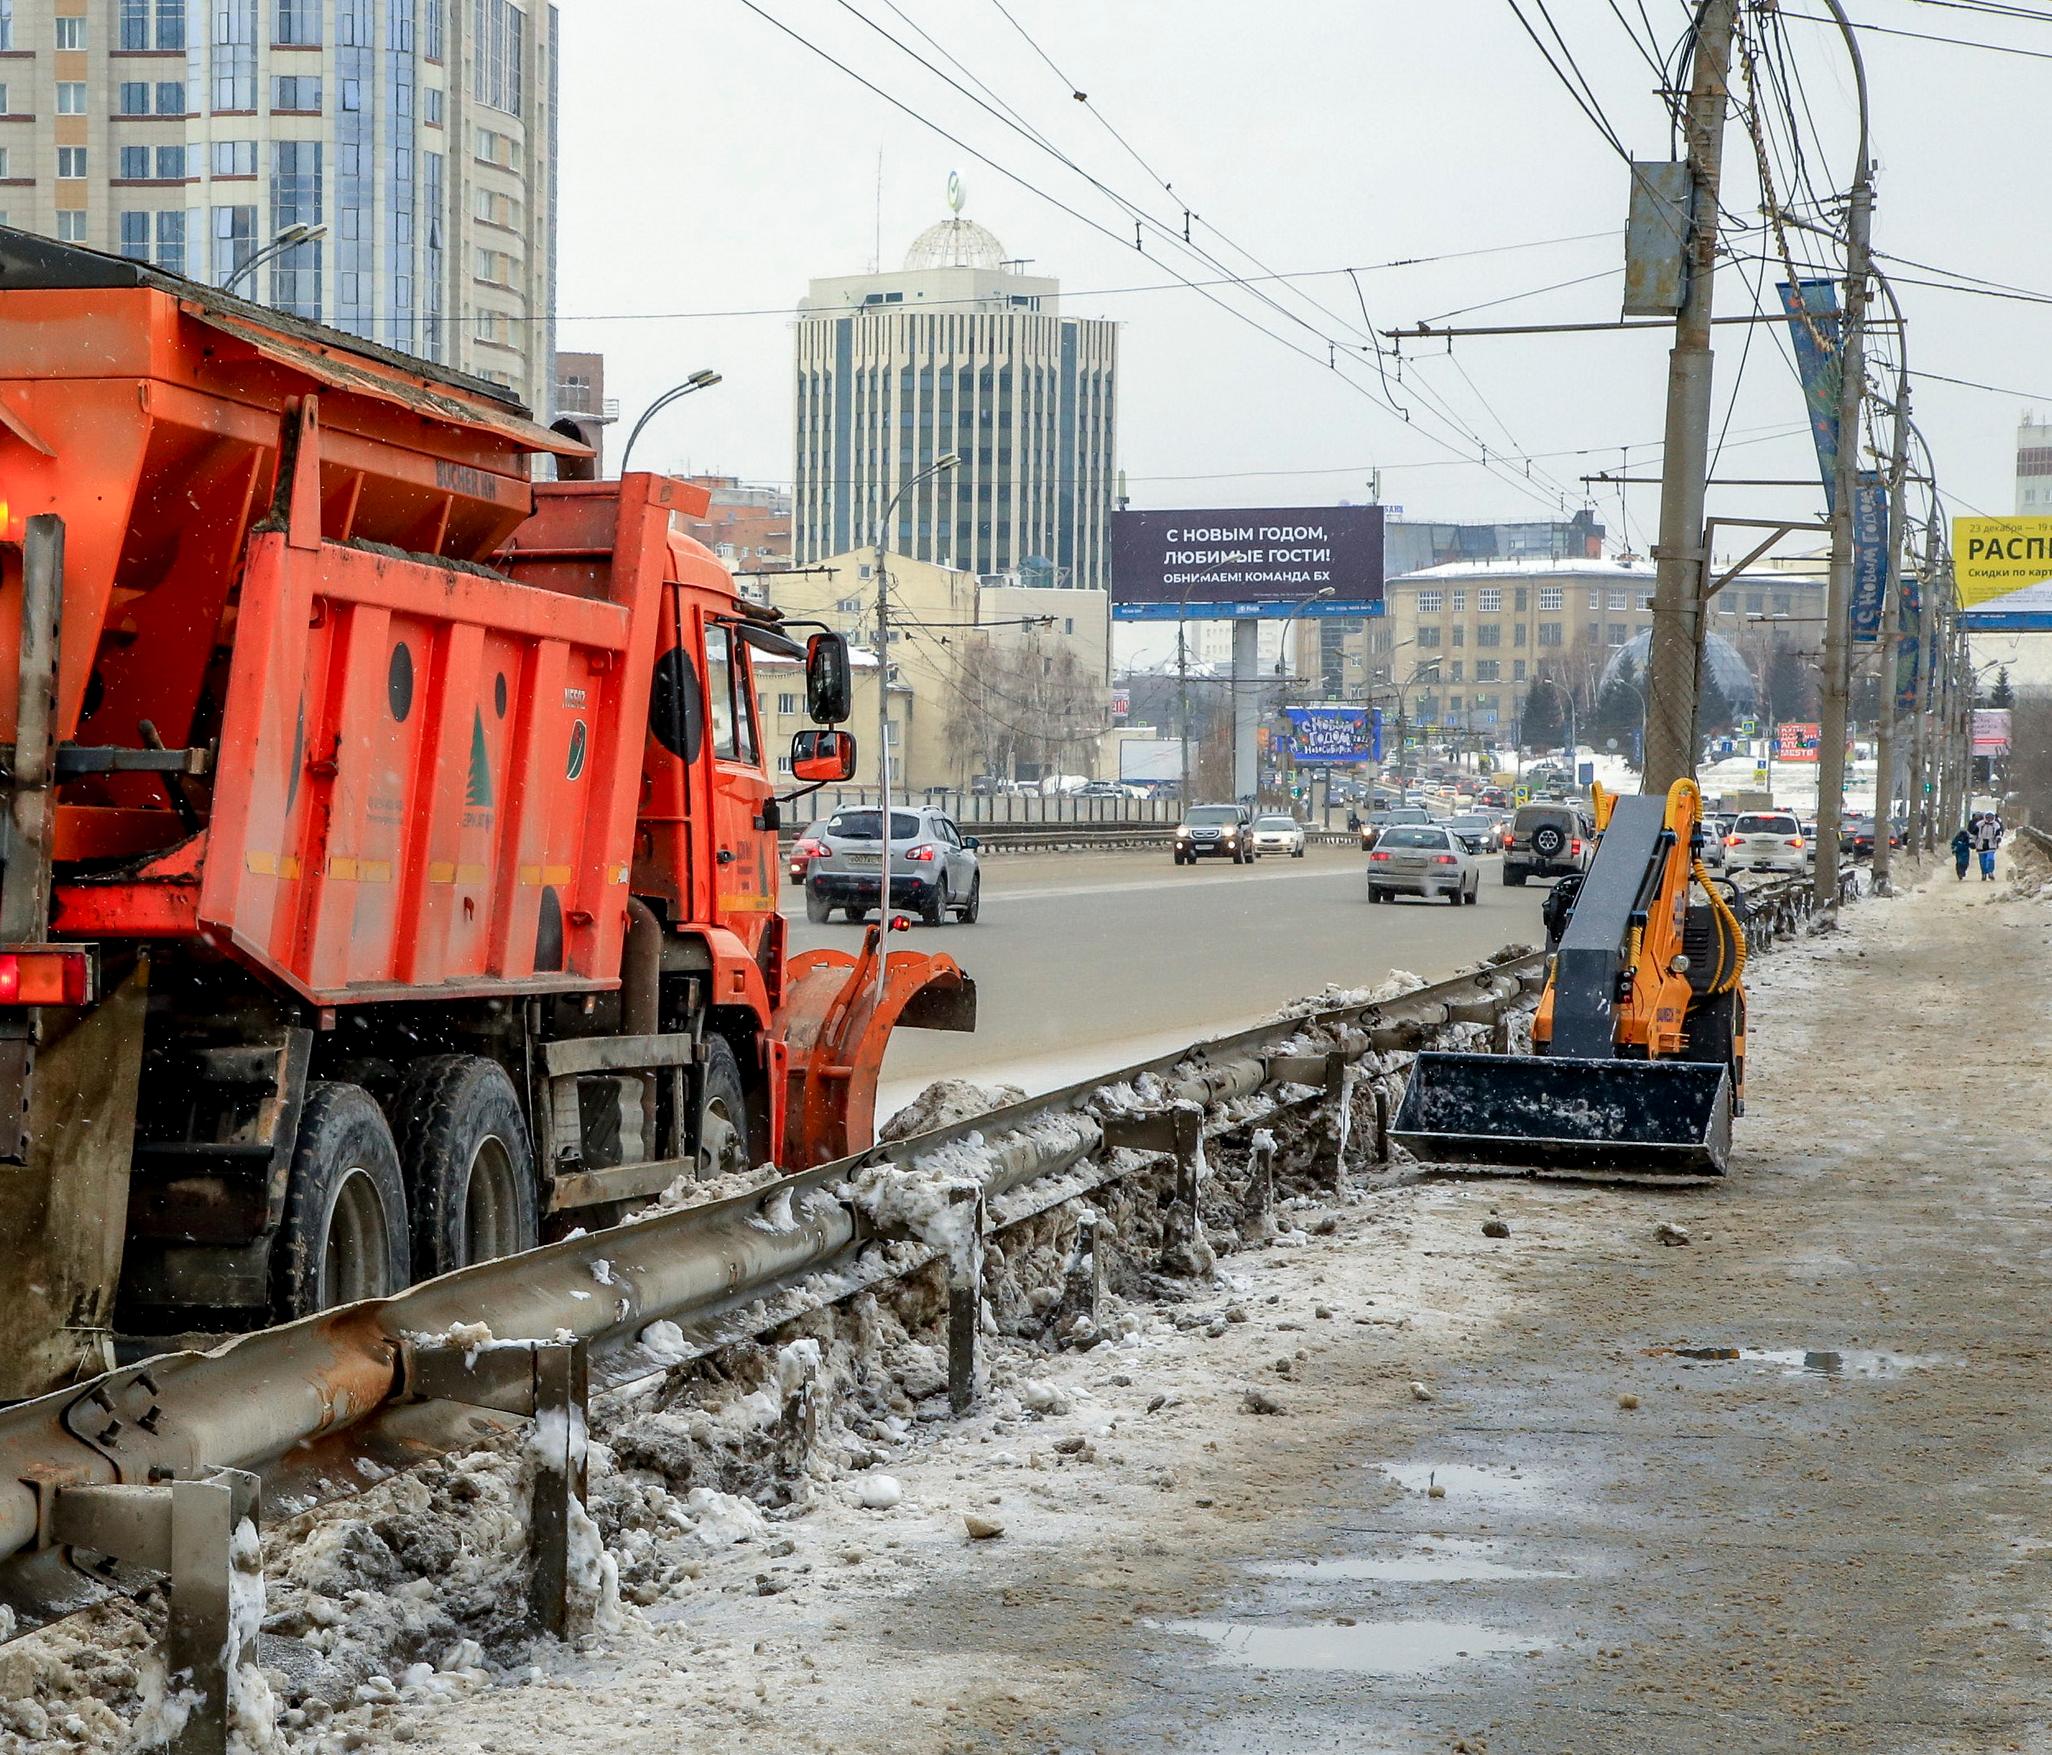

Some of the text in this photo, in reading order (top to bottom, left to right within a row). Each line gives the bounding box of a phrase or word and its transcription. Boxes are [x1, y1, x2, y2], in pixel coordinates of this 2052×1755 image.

[1167, 527, 1328, 542] С НОВЫМ ГОДОМ,
[1984, 523, 2023, 533] декабря
[1164, 549, 1330, 565] ЛЮБИМЫЕ ГОСТИ!
[1164, 571, 1330, 584] ОБНИМАЕМ! КОМАНДА БХ
[1969, 569, 2009, 578] Скидки
